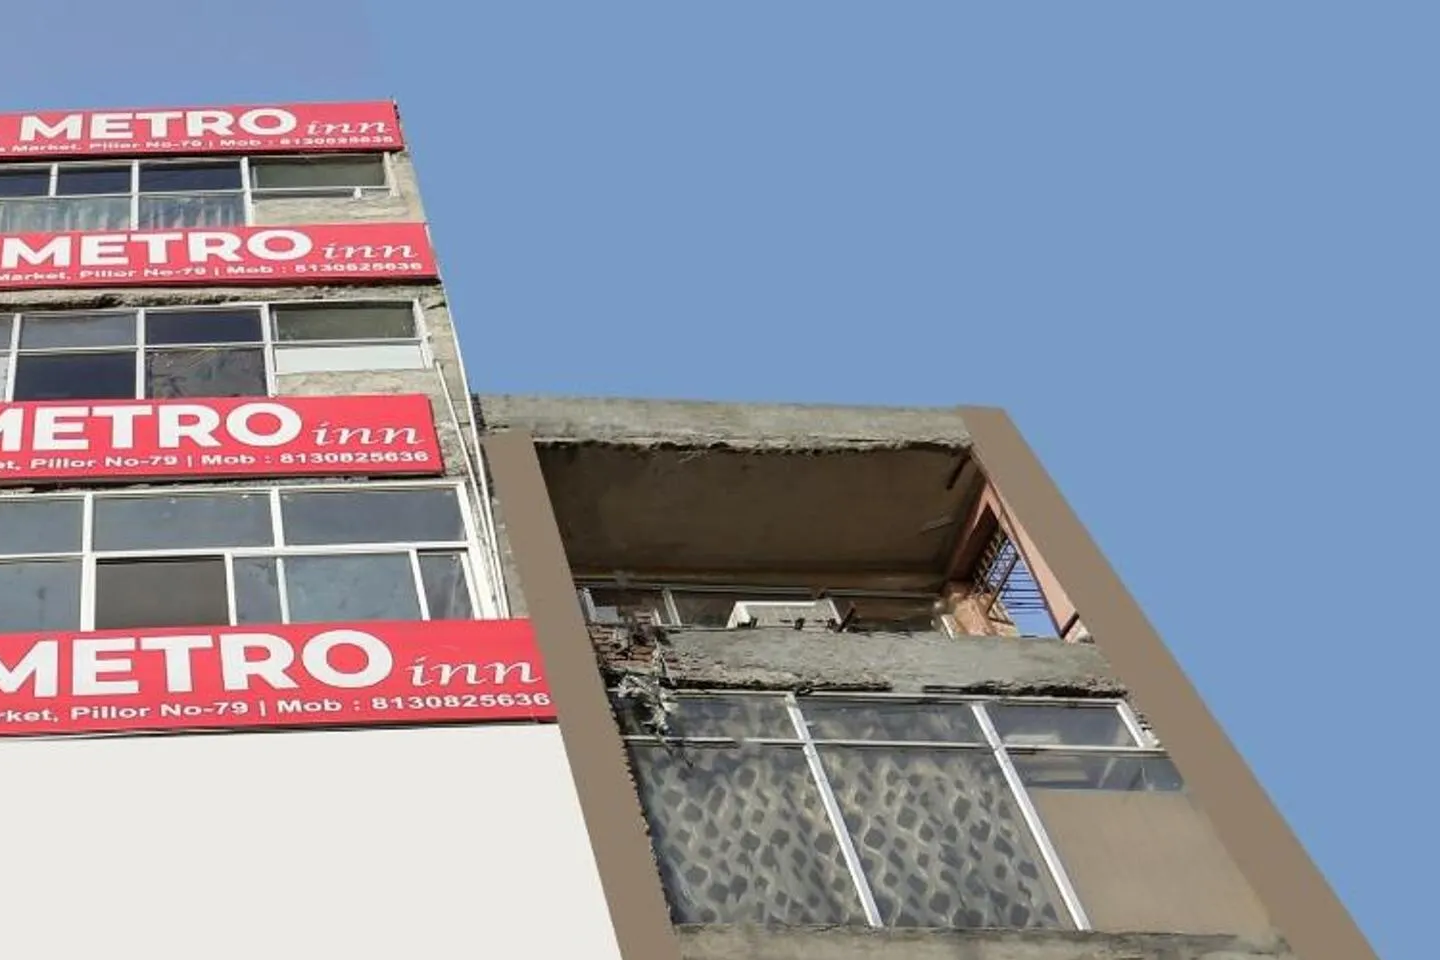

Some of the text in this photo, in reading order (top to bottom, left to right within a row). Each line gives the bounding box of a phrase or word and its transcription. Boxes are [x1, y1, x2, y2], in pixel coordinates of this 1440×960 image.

[20, 108, 297, 141] METRO
[306, 120, 391, 136] inn
[1, 229, 313, 270] METRO
[321, 243, 418, 260] inn
[227, 264, 274, 275] Mob
[312, 423, 425, 446] inn
[30, 457, 94, 469] Pillor
[105, 455, 178, 468] No-79
[202, 453, 256, 465] Mob
[280, 450, 428, 463] 8130825636
[405, 655, 542, 689] inn
[70, 705, 151, 720] Pillor
[161, 702, 248, 717] No-79
[277, 698, 342, 713] Mob
[371, 692, 550, 709] 8130825636
